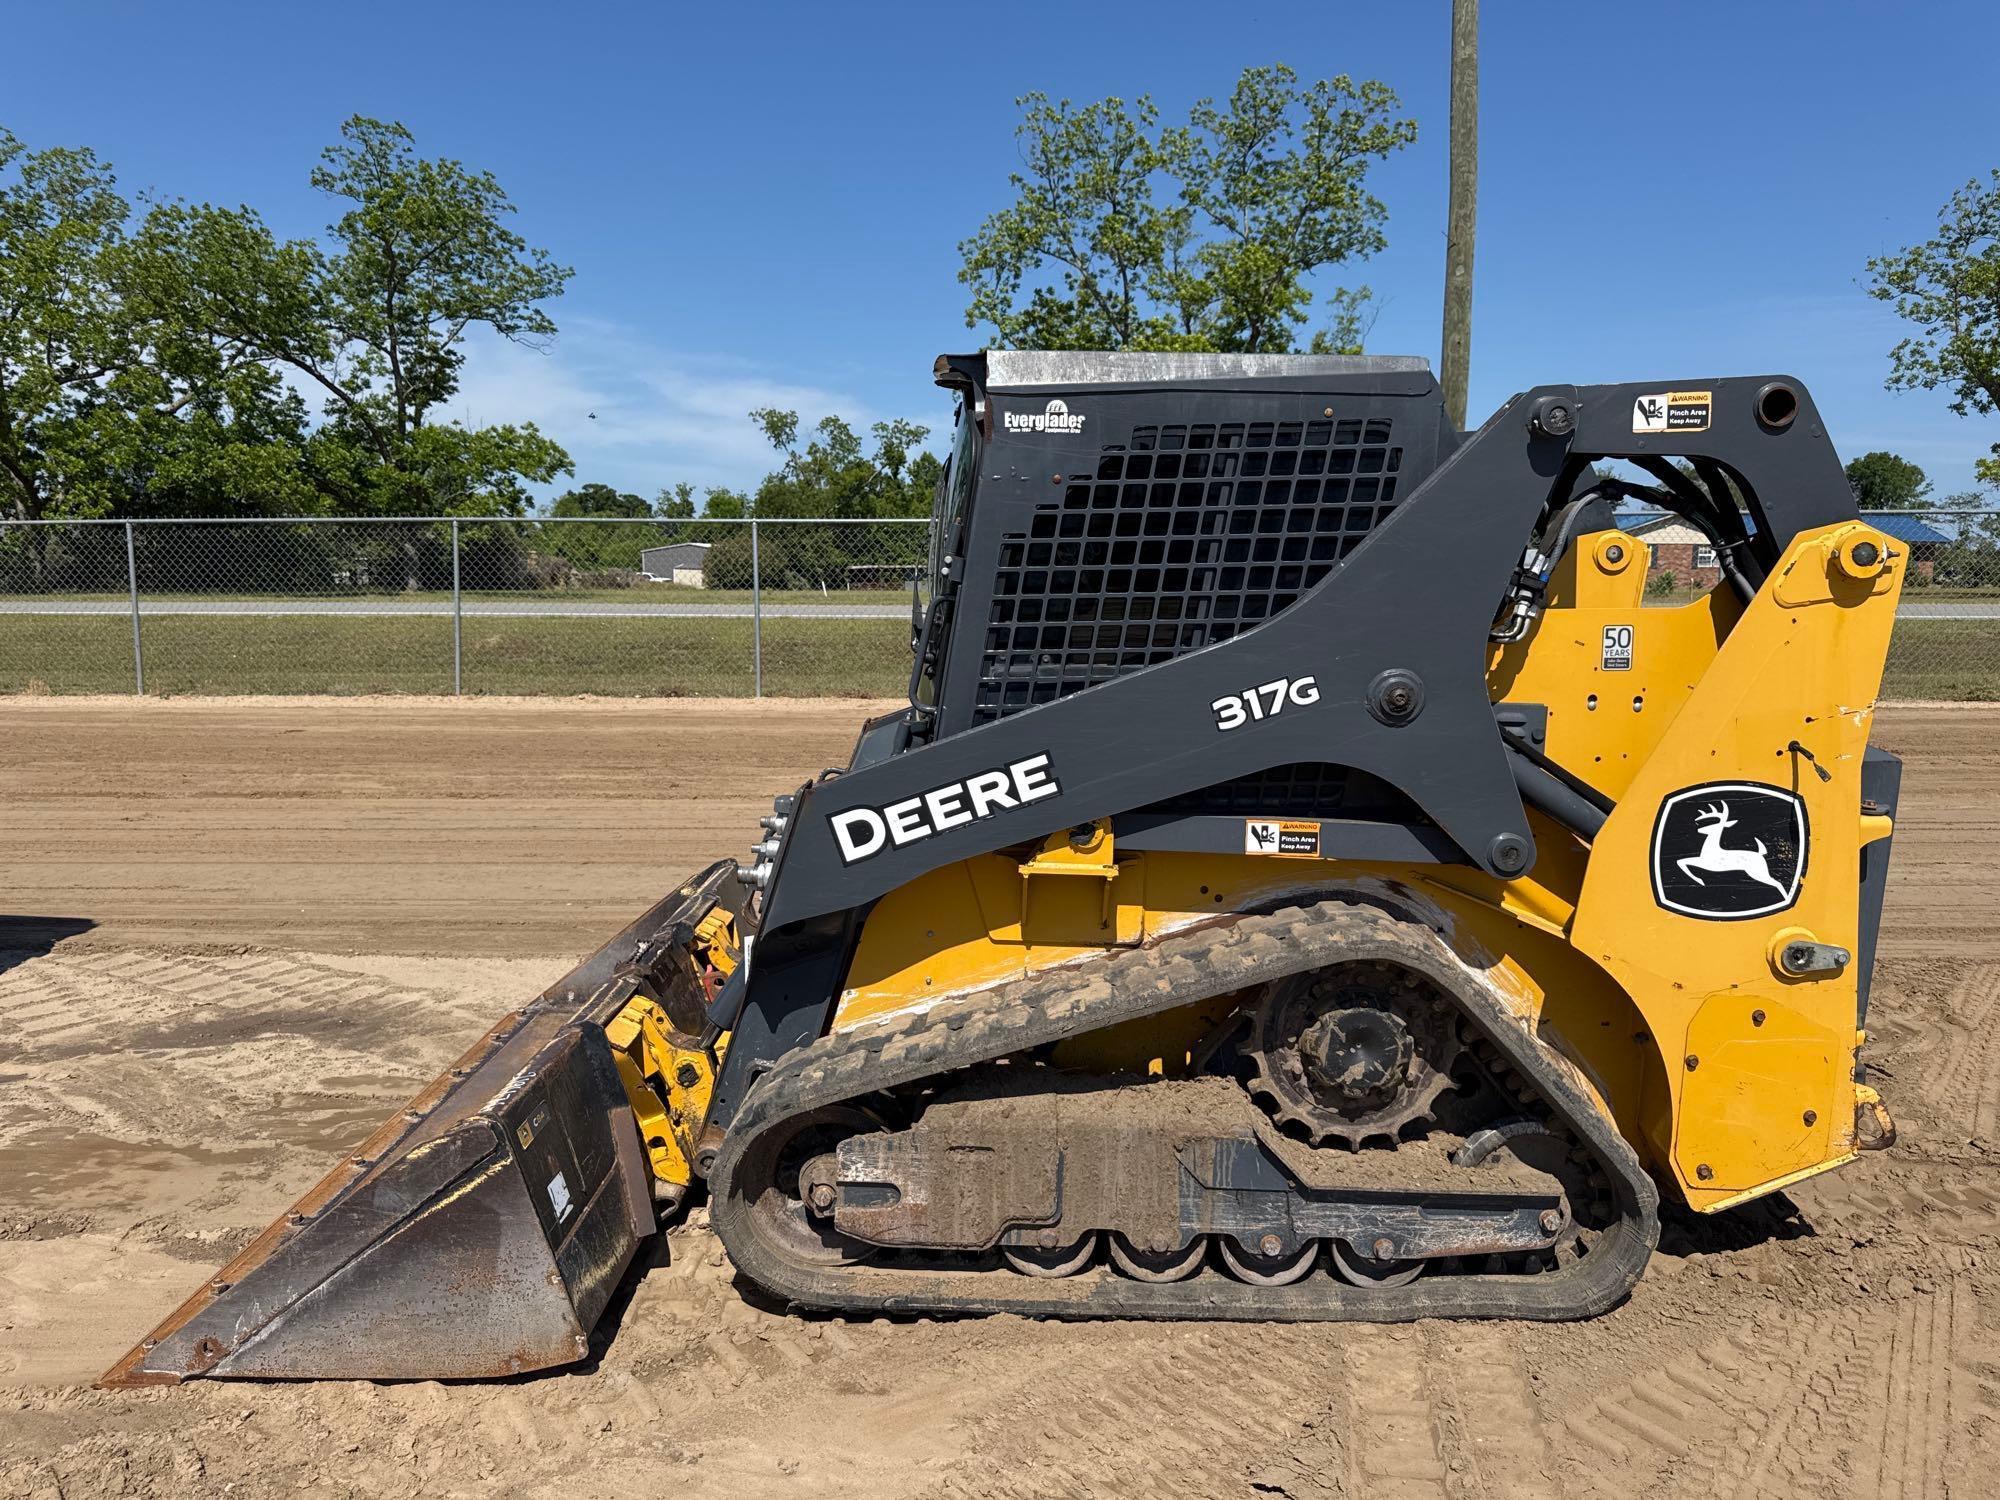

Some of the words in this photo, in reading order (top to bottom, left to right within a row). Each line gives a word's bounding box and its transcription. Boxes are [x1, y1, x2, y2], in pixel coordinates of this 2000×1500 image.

[1604, 627, 1632, 649] 50
[1604, 649, 1631, 657] YEARS
[1211, 675, 1321, 731] 317G
[830, 753, 1059, 864] DEERE
